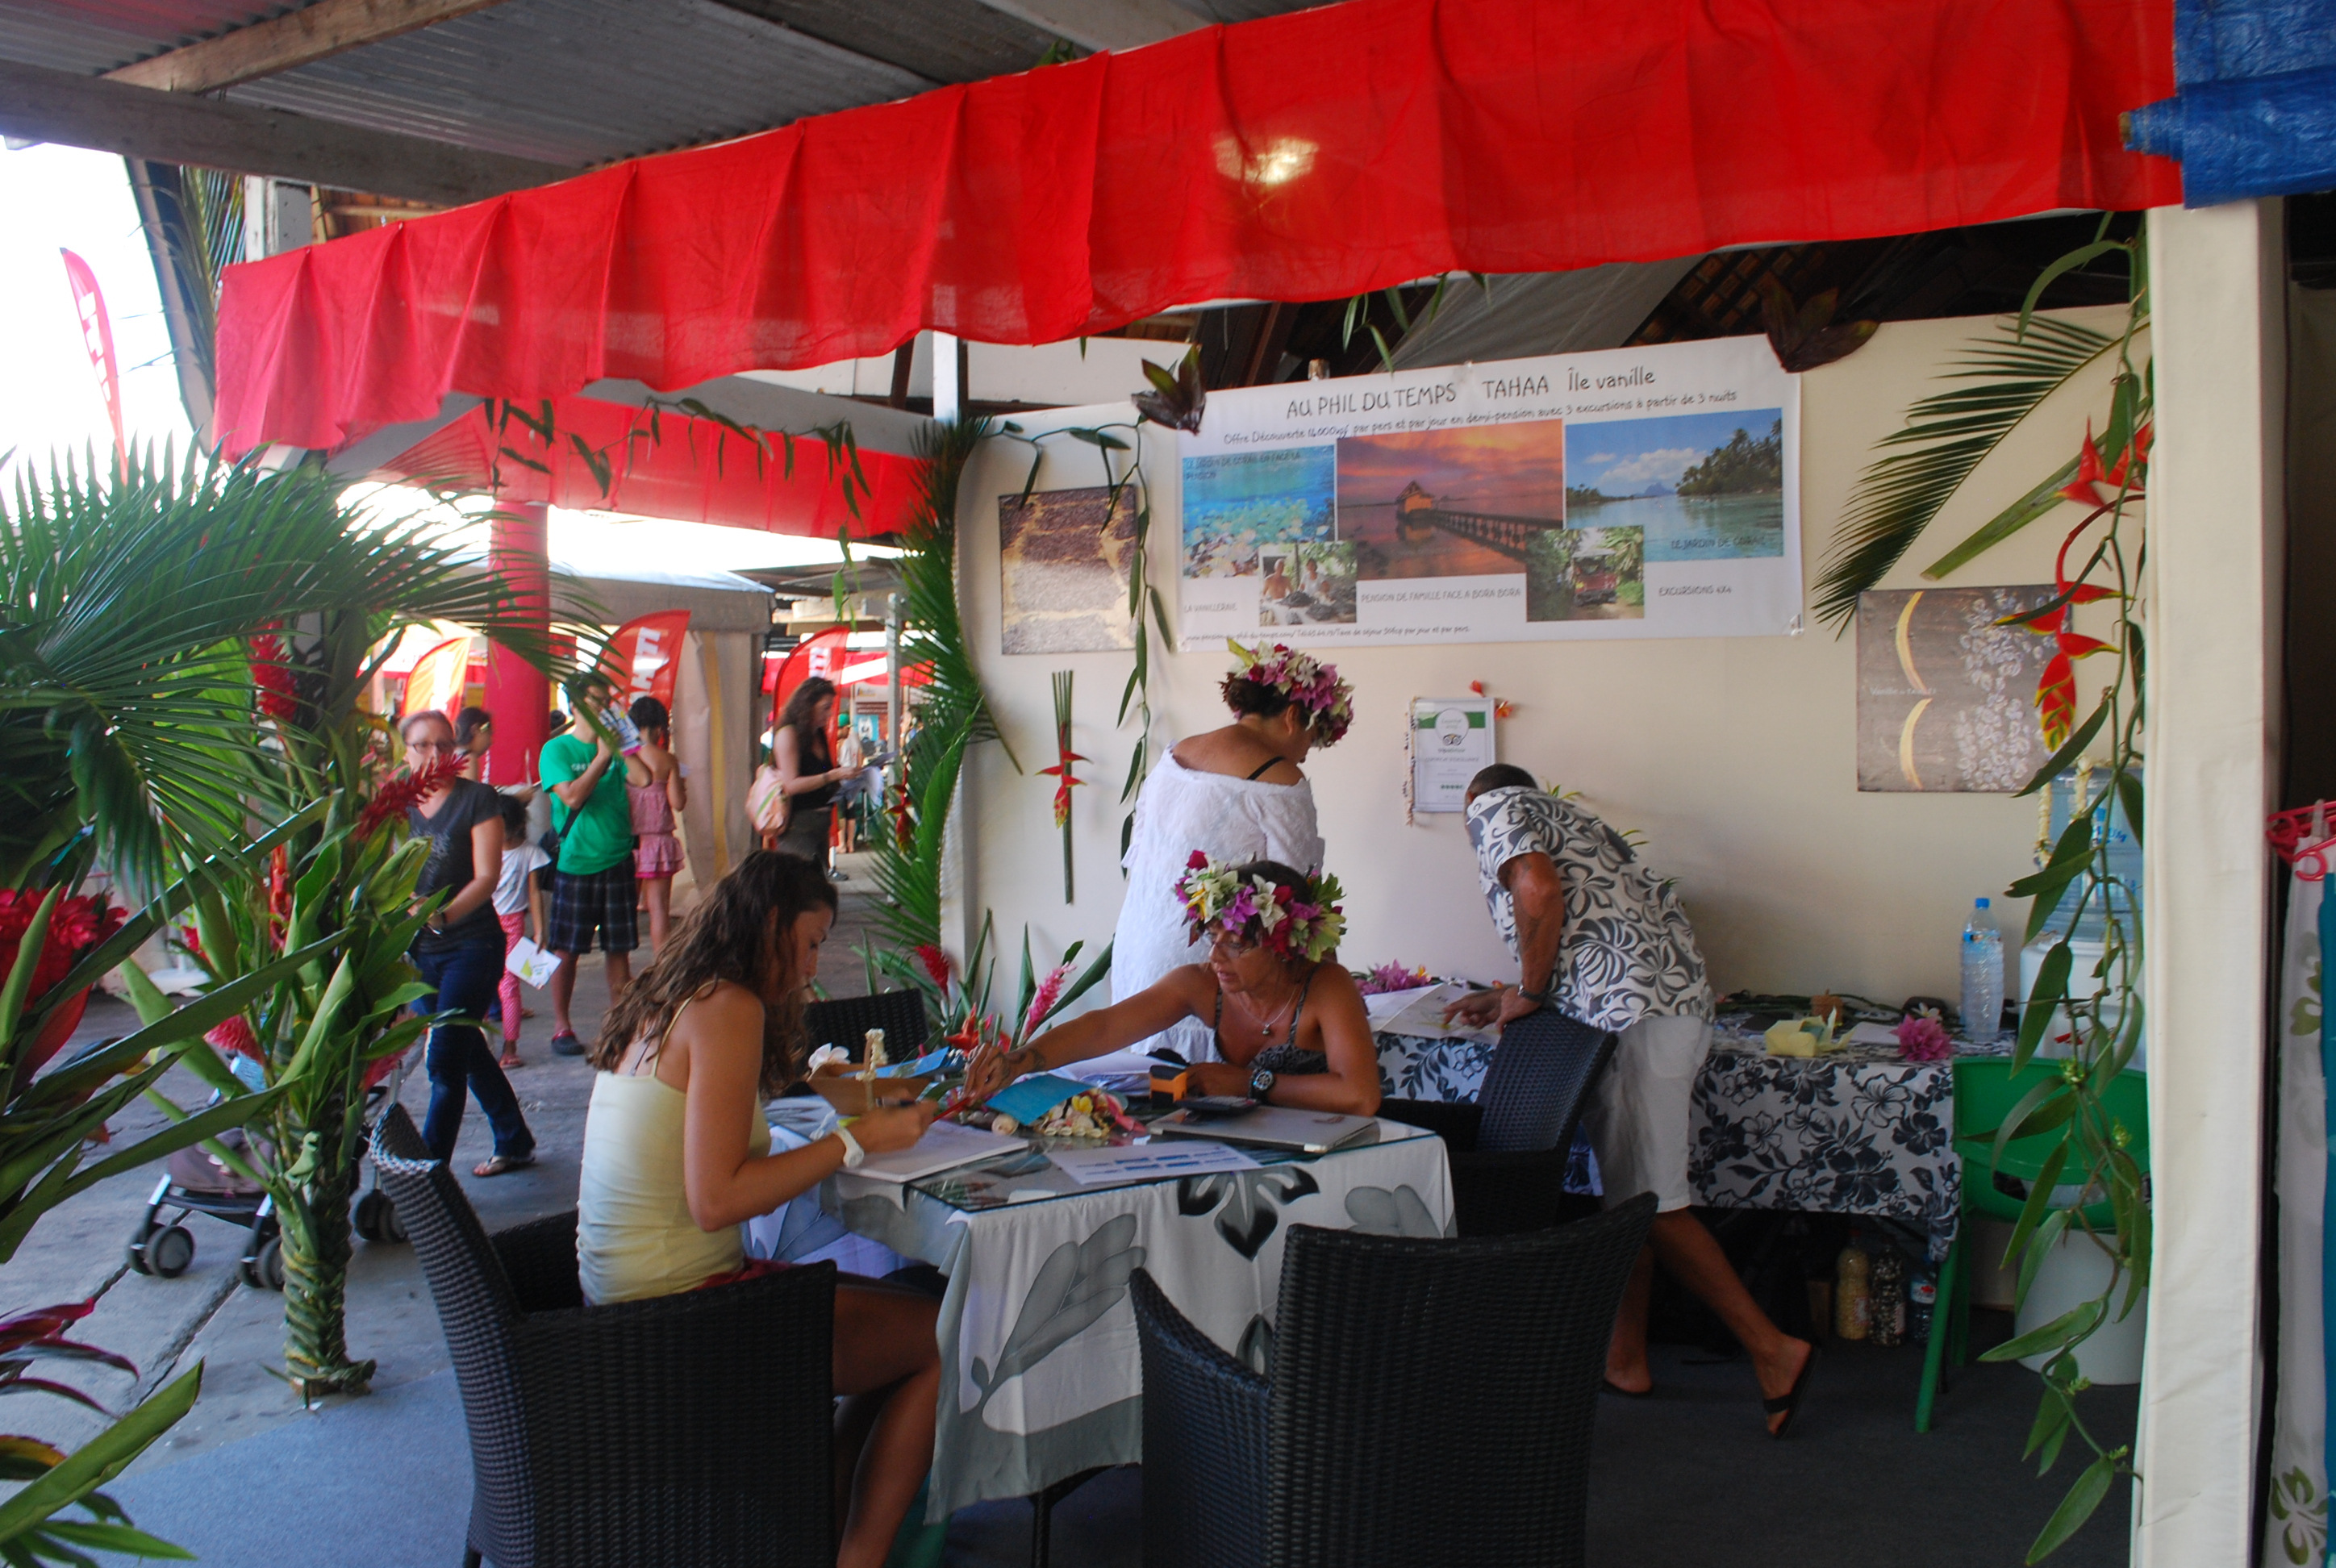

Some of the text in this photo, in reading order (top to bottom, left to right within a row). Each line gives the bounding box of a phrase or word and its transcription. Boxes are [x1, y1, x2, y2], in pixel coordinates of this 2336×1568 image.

[1287, 365, 1656, 419] AU PHIL DU TEMPS TAHAA Île vanille
[1224, 432, 1250, 445] Offre
[1252, 427, 1306, 444] Découverte
[1354, 423, 1370, 437] par
[1371, 420, 1392, 436] pers
[1395, 418, 1407, 430] et
[1408, 419, 1425, 432] par
[1426, 415, 1448, 431] jour
[1450, 415, 1463, 425] en
[1466, 405, 1534, 424] demi-pension
[1537, 406, 1563, 418] avec
[1565, 404, 1572, 416] 3
[1575, 399, 1633, 414] excursions
[1647, 393, 1677, 412] partir
[1680, 393, 1696, 405] de
[1698, 391, 1705, 404] 3
[1708, 388, 1737, 404] nuits
[1717, 537, 1732, 548] DE
[1361, 593, 1395, 603] PENSION
[1396, 592, 1408, 602] DE
[1410, 591, 1441, 602] FAMILLE
[1442, 590, 1462, 600] FACE
[1472, 589, 1495, 600] BORA
[1497, 587, 1521, 598] BORA
[1658, 585, 1715, 597] EXCURSIONS
